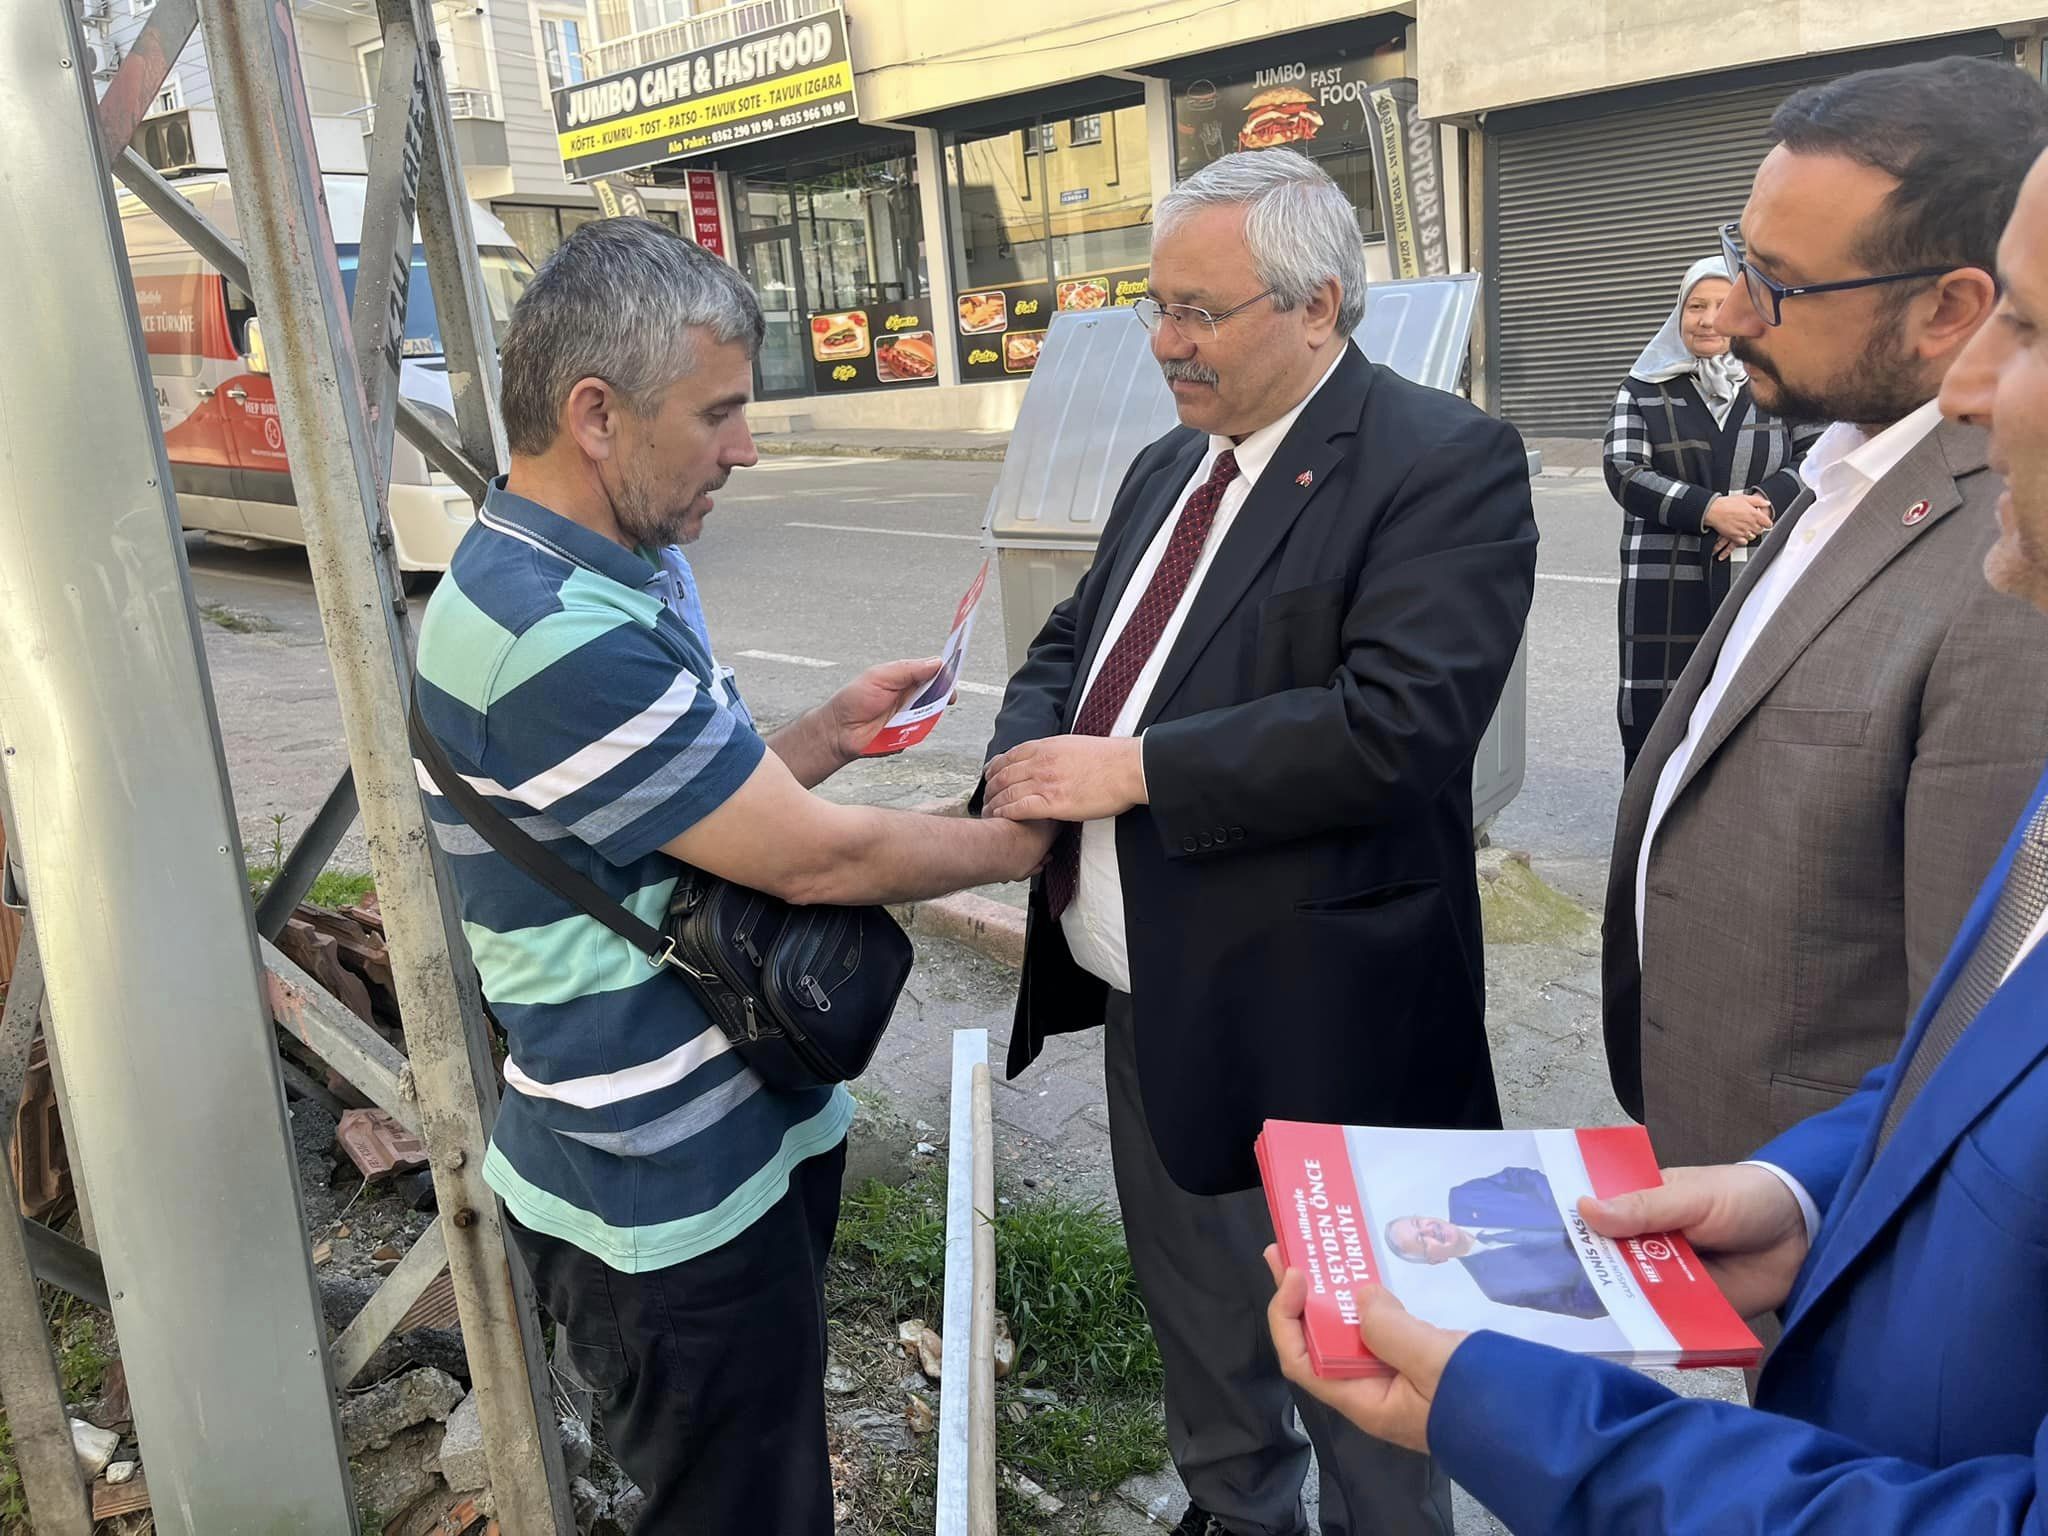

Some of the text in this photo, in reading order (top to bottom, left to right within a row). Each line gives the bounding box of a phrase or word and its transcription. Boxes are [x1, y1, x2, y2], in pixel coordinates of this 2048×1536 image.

[566, 22, 832, 127] JUMBO CAFE & FASTFOOD
[1252, 62, 1306, 89] JUMBO
[1310, 67, 1343, 88] FAST
[570, 131, 595, 152] KÖFTE
[602, 126, 633, 145] KUMRU
[639, 119, 661, 136] TOST
[668, 110, 698, 129] PATSO
[705, 99, 736, 118] TAVUK
[738, 94, 761, 113] SOTE
[769, 83, 802, 104] TAVUK
[698, 223, 717, 232] TOST
[156, 309, 195, 333] TÜRKİYE
[1293, 1188, 1313, 1241] Milletiyle
[1304, 1159, 1361, 1325] HER ŞEYDEN ÖNCE
[1306, 1243, 1317, 1256] ve
[1335, 1204, 1370, 1282] TÜRKİYE
[1585, 1248, 1613, 1286] YUNİS
